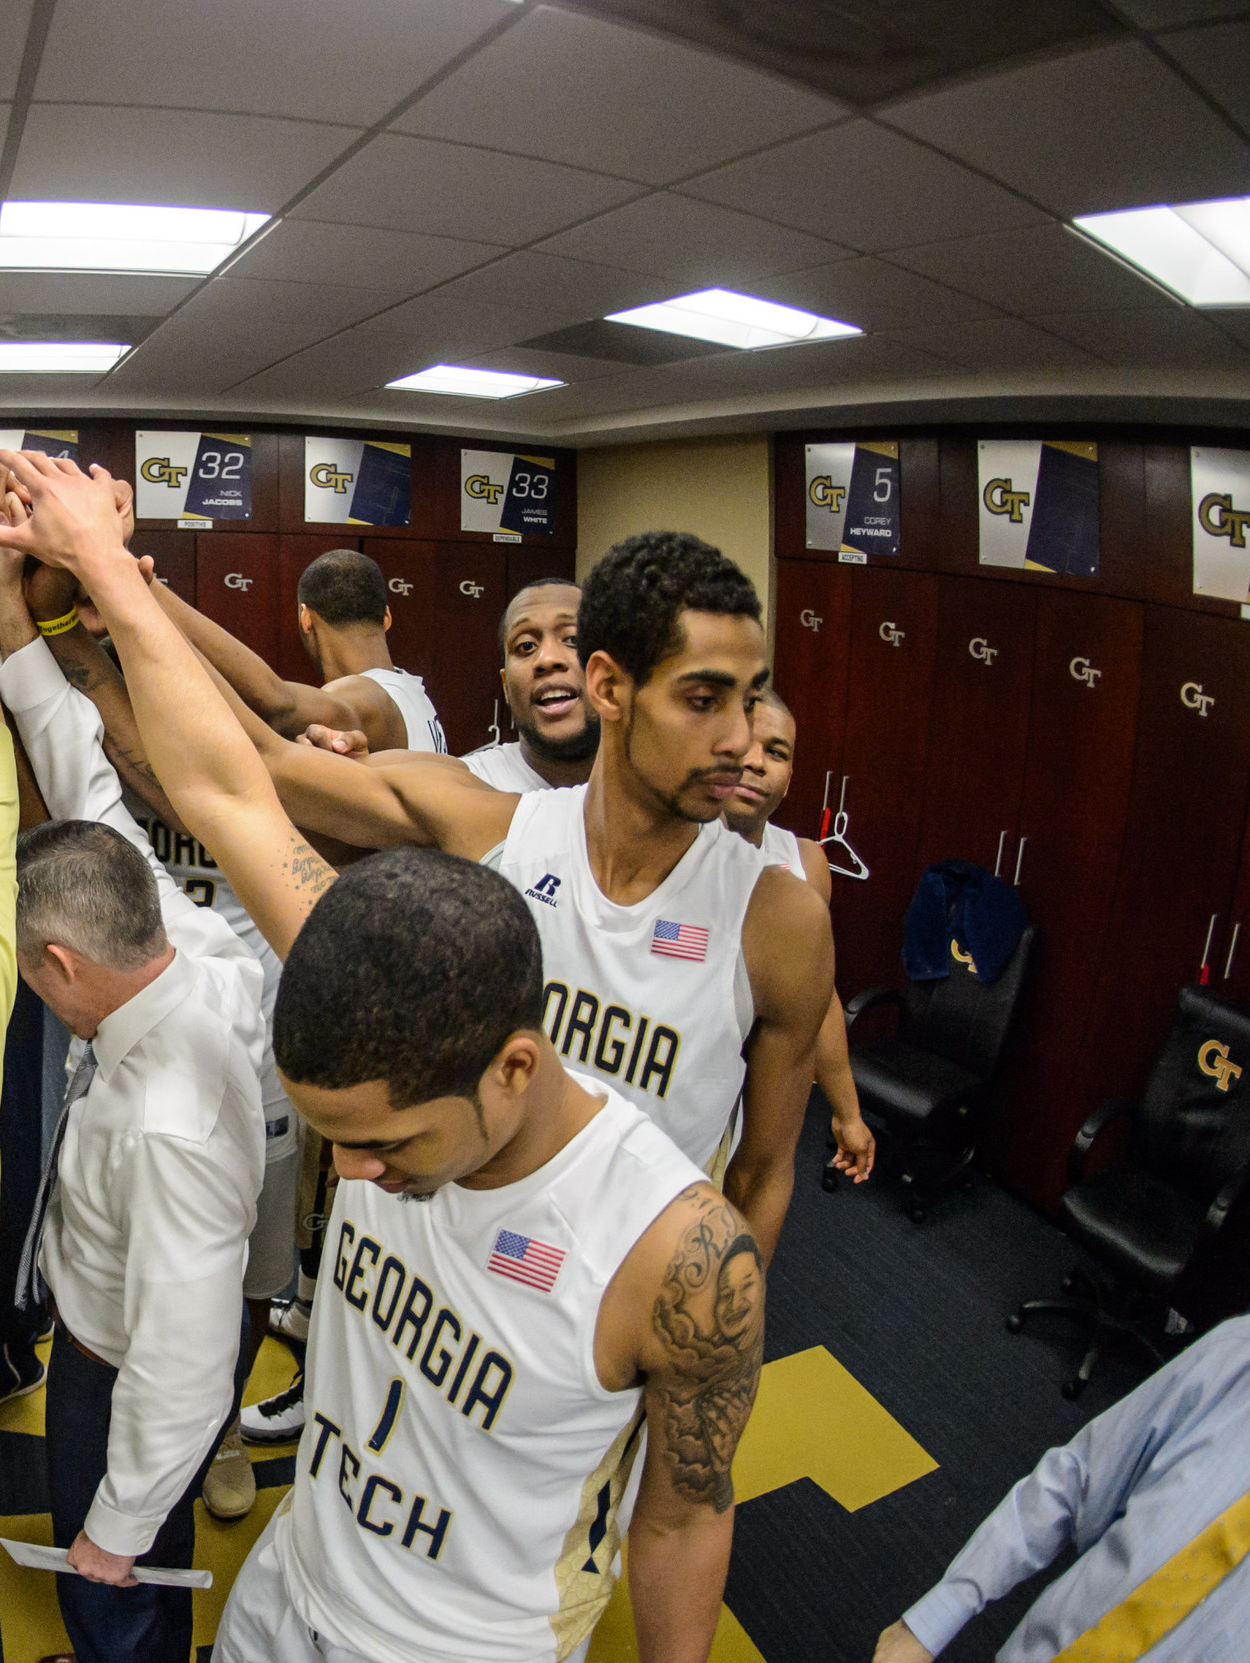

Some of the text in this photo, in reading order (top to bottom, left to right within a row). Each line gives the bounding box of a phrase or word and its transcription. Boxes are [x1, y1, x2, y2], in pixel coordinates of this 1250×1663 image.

[141, 457, 188, 488] GT
[198, 452, 244, 479] 32
[309, 463, 353, 494] GT
[465, 474, 504, 505] GT
[512, 473, 549, 499] 33
[809, 475, 845, 513] GT
[873, 467, 892, 502] 5
[521, 508, 547, 516] JAMES
[983, 478, 1030, 524] GT
[523, 516, 548, 524] WHITE
[850, 528, 892, 537] HEYWARD
[864, 517, 892, 525] COREY
[524, 888, 558, 908] RUSSELL
[543, 978, 681, 1101] ORGIA
[332, 1219, 517, 1434] GEORGIA
[364, 1376, 406, 1457] 1
[311, 1408, 455, 1562] TECH
